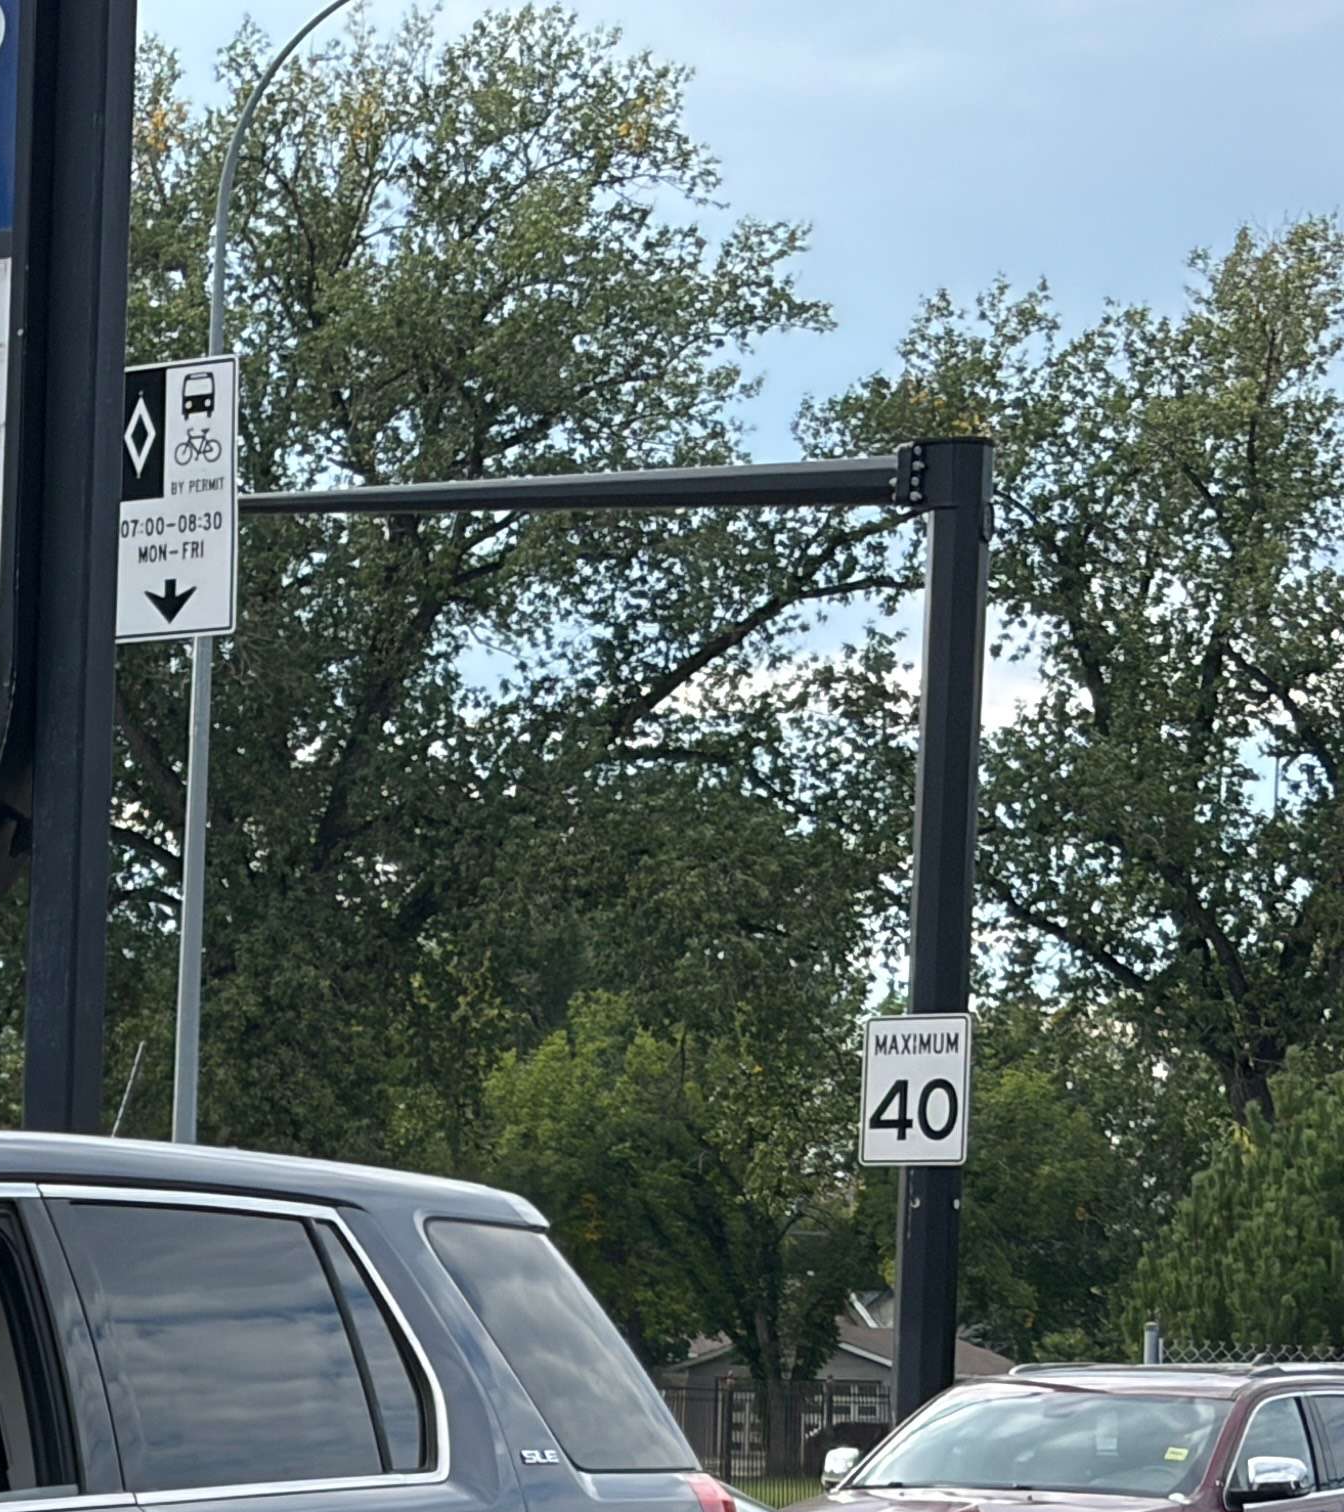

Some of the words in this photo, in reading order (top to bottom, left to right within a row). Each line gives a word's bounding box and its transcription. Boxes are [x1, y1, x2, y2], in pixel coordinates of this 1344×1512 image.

[171, 481, 185, 495] BY
[189, 477, 224, 494] PERMIT
[120, 511, 223, 538] 07:00-08:30
[875, 1032, 959, 1056] MAXIMUM
[869, 1078, 959, 1141] 40
[520, 1449, 560, 1465] SLE
